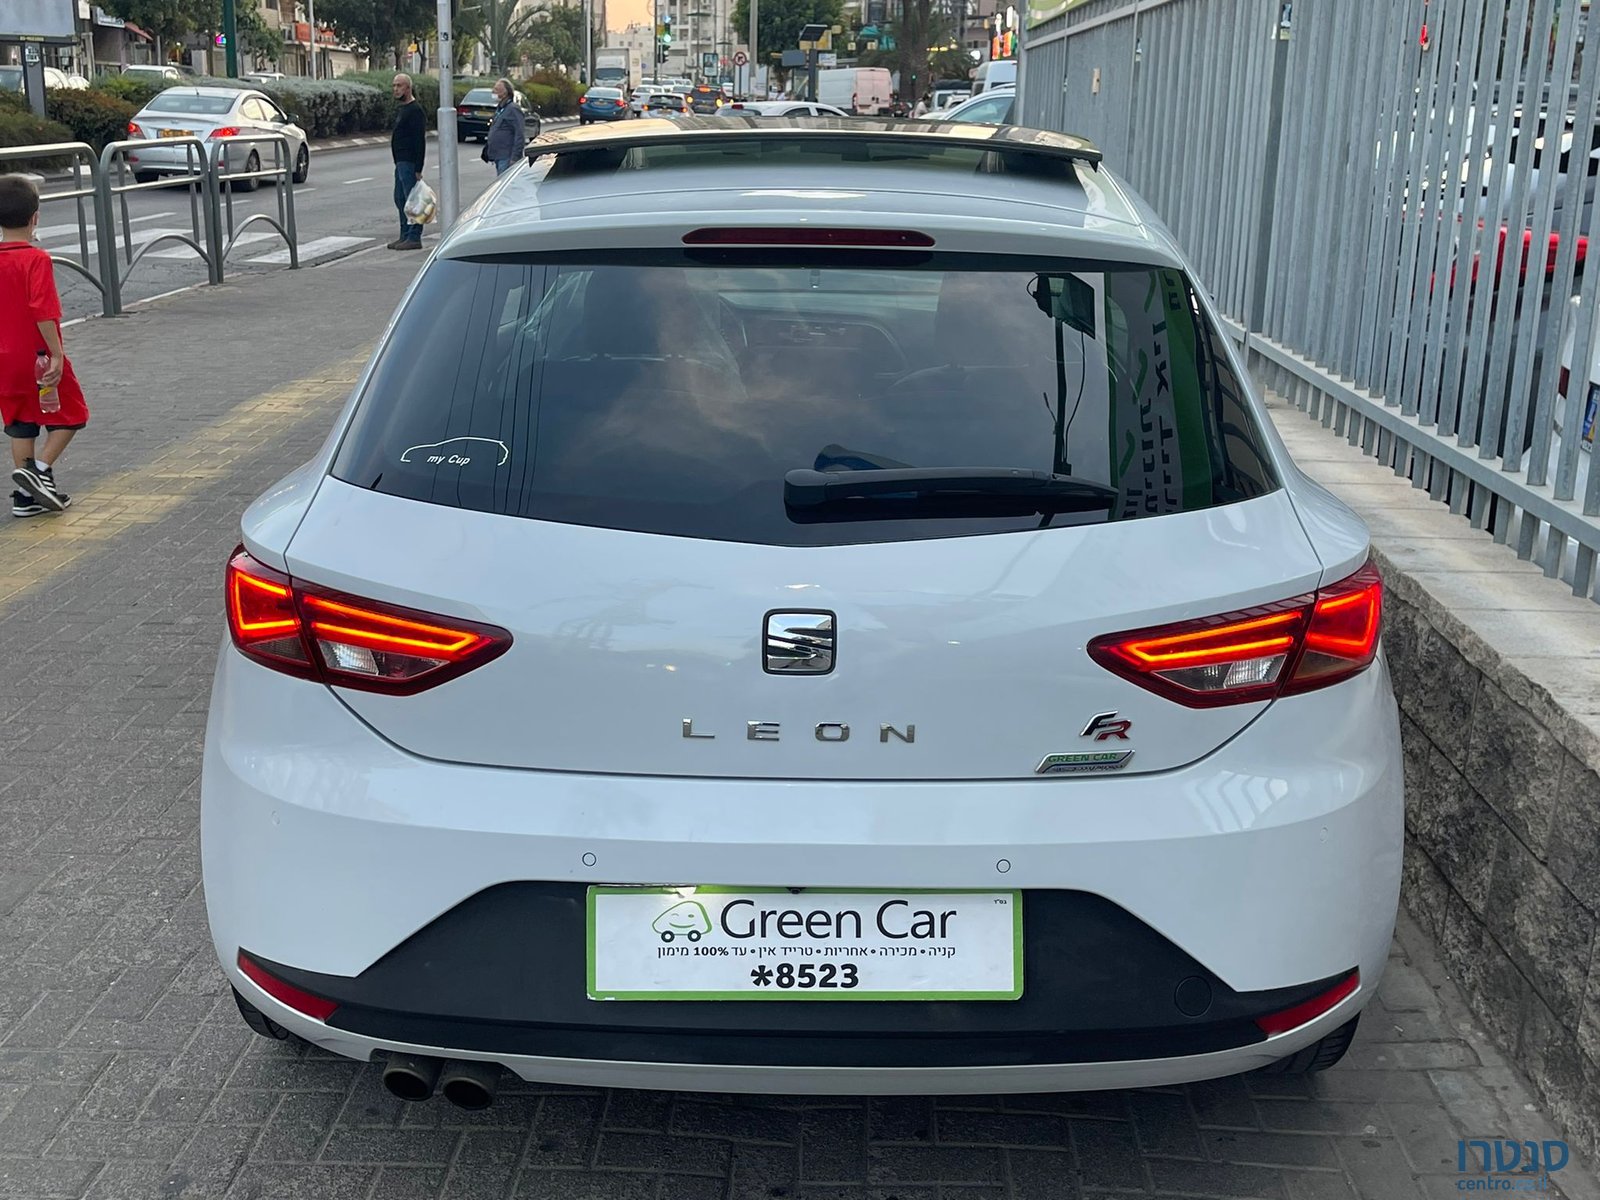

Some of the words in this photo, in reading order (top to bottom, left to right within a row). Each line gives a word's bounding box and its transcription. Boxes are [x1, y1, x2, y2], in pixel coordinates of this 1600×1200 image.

[426, 455, 446, 465] my
[448, 454, 471, 467] Cup
[682, 718, 916, 743] LEON
[1080, 710, 1132, 740] FR
[1048, 755, 1090, 763] GREEN
[1093, 753, 1118, 761] CAR
[720, 899, 862, 939] Green
[876, 899, 957, 939] Car
[657, 946, 689, 959] מימון
[693, 945, 729, 957] 100%
[731, 946, 747, 957] עד
[758, 946, 777, 959] אין
[780, 946, 813, 957] טרייד
[824, 946, 868, 957] אחריות
[879, 946, 917, 957] מכירה
[928, 946, 956, 959] קניה
